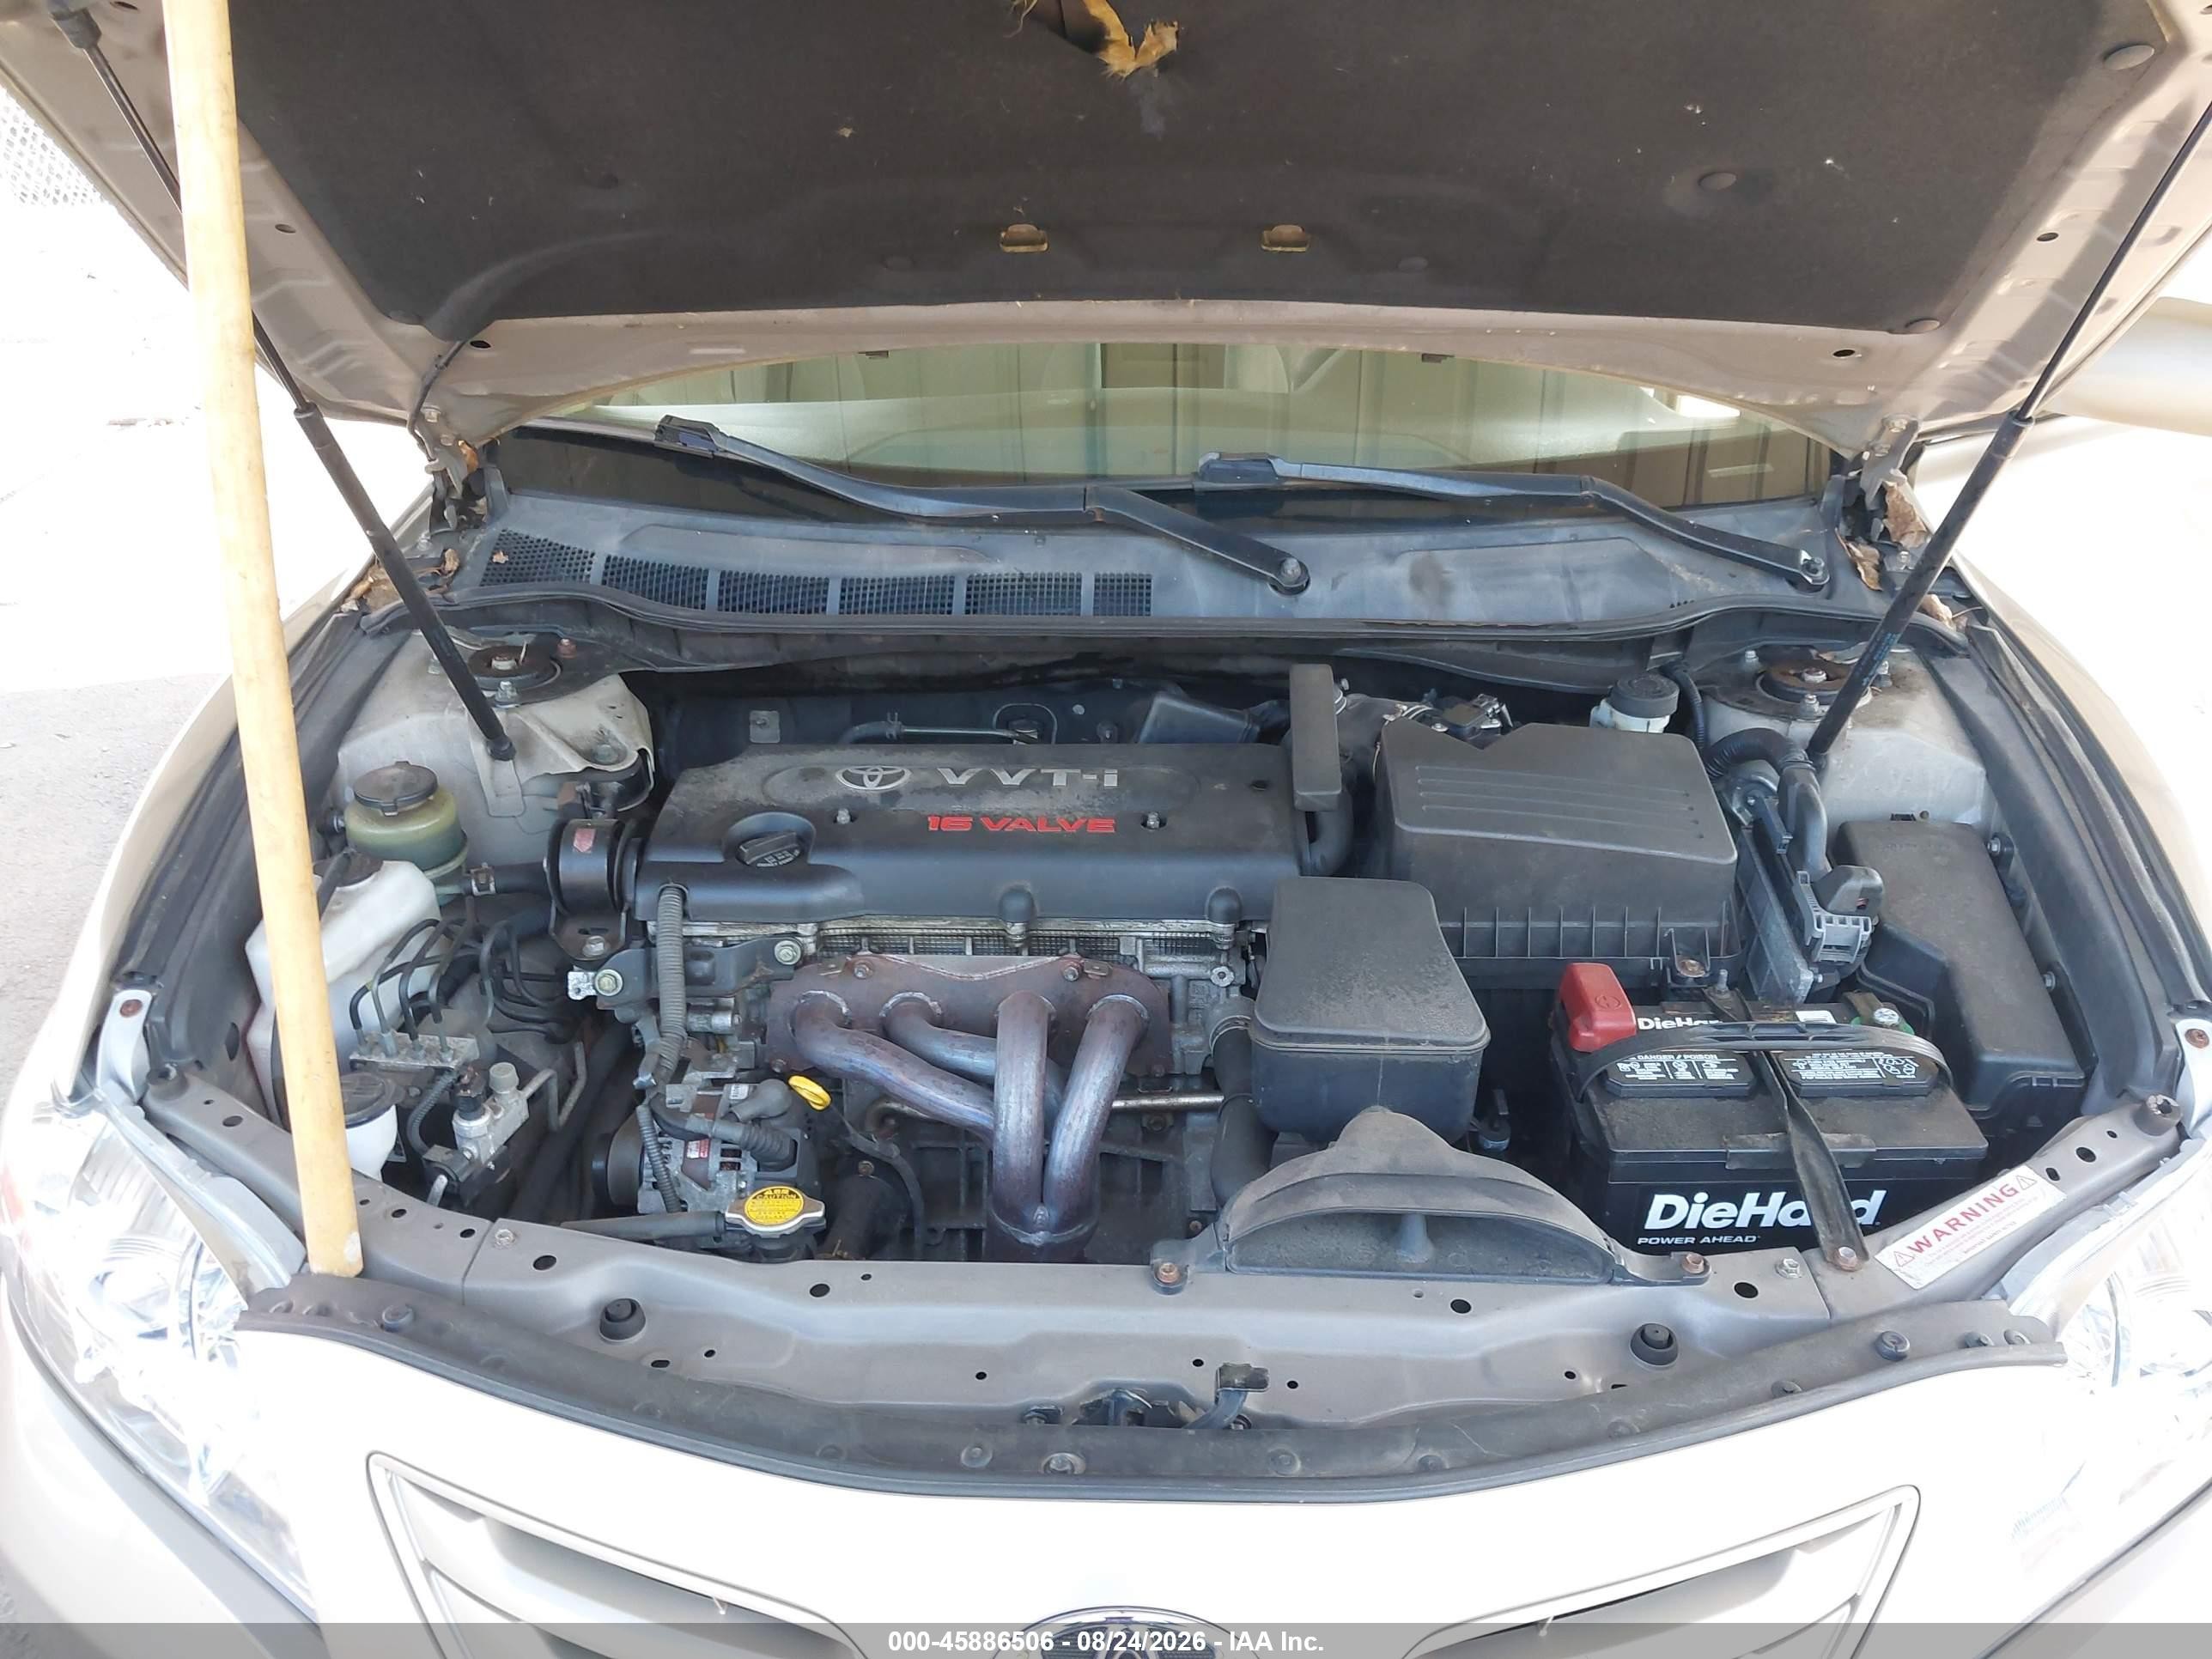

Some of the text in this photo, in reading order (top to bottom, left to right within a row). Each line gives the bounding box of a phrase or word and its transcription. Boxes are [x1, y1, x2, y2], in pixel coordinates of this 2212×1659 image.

[937, 768, 1118, 787] VVT-i
[928, 816, 1115, 833] 16 VALVE
[1637, 1017, 1723, 1030] DieH
[1644, 1190, 1887, 1230] DieHad
[1907, 1183, 2019, 1254] WARNING
[1638, 1235, 1757, 1245] POWER AHEAD
